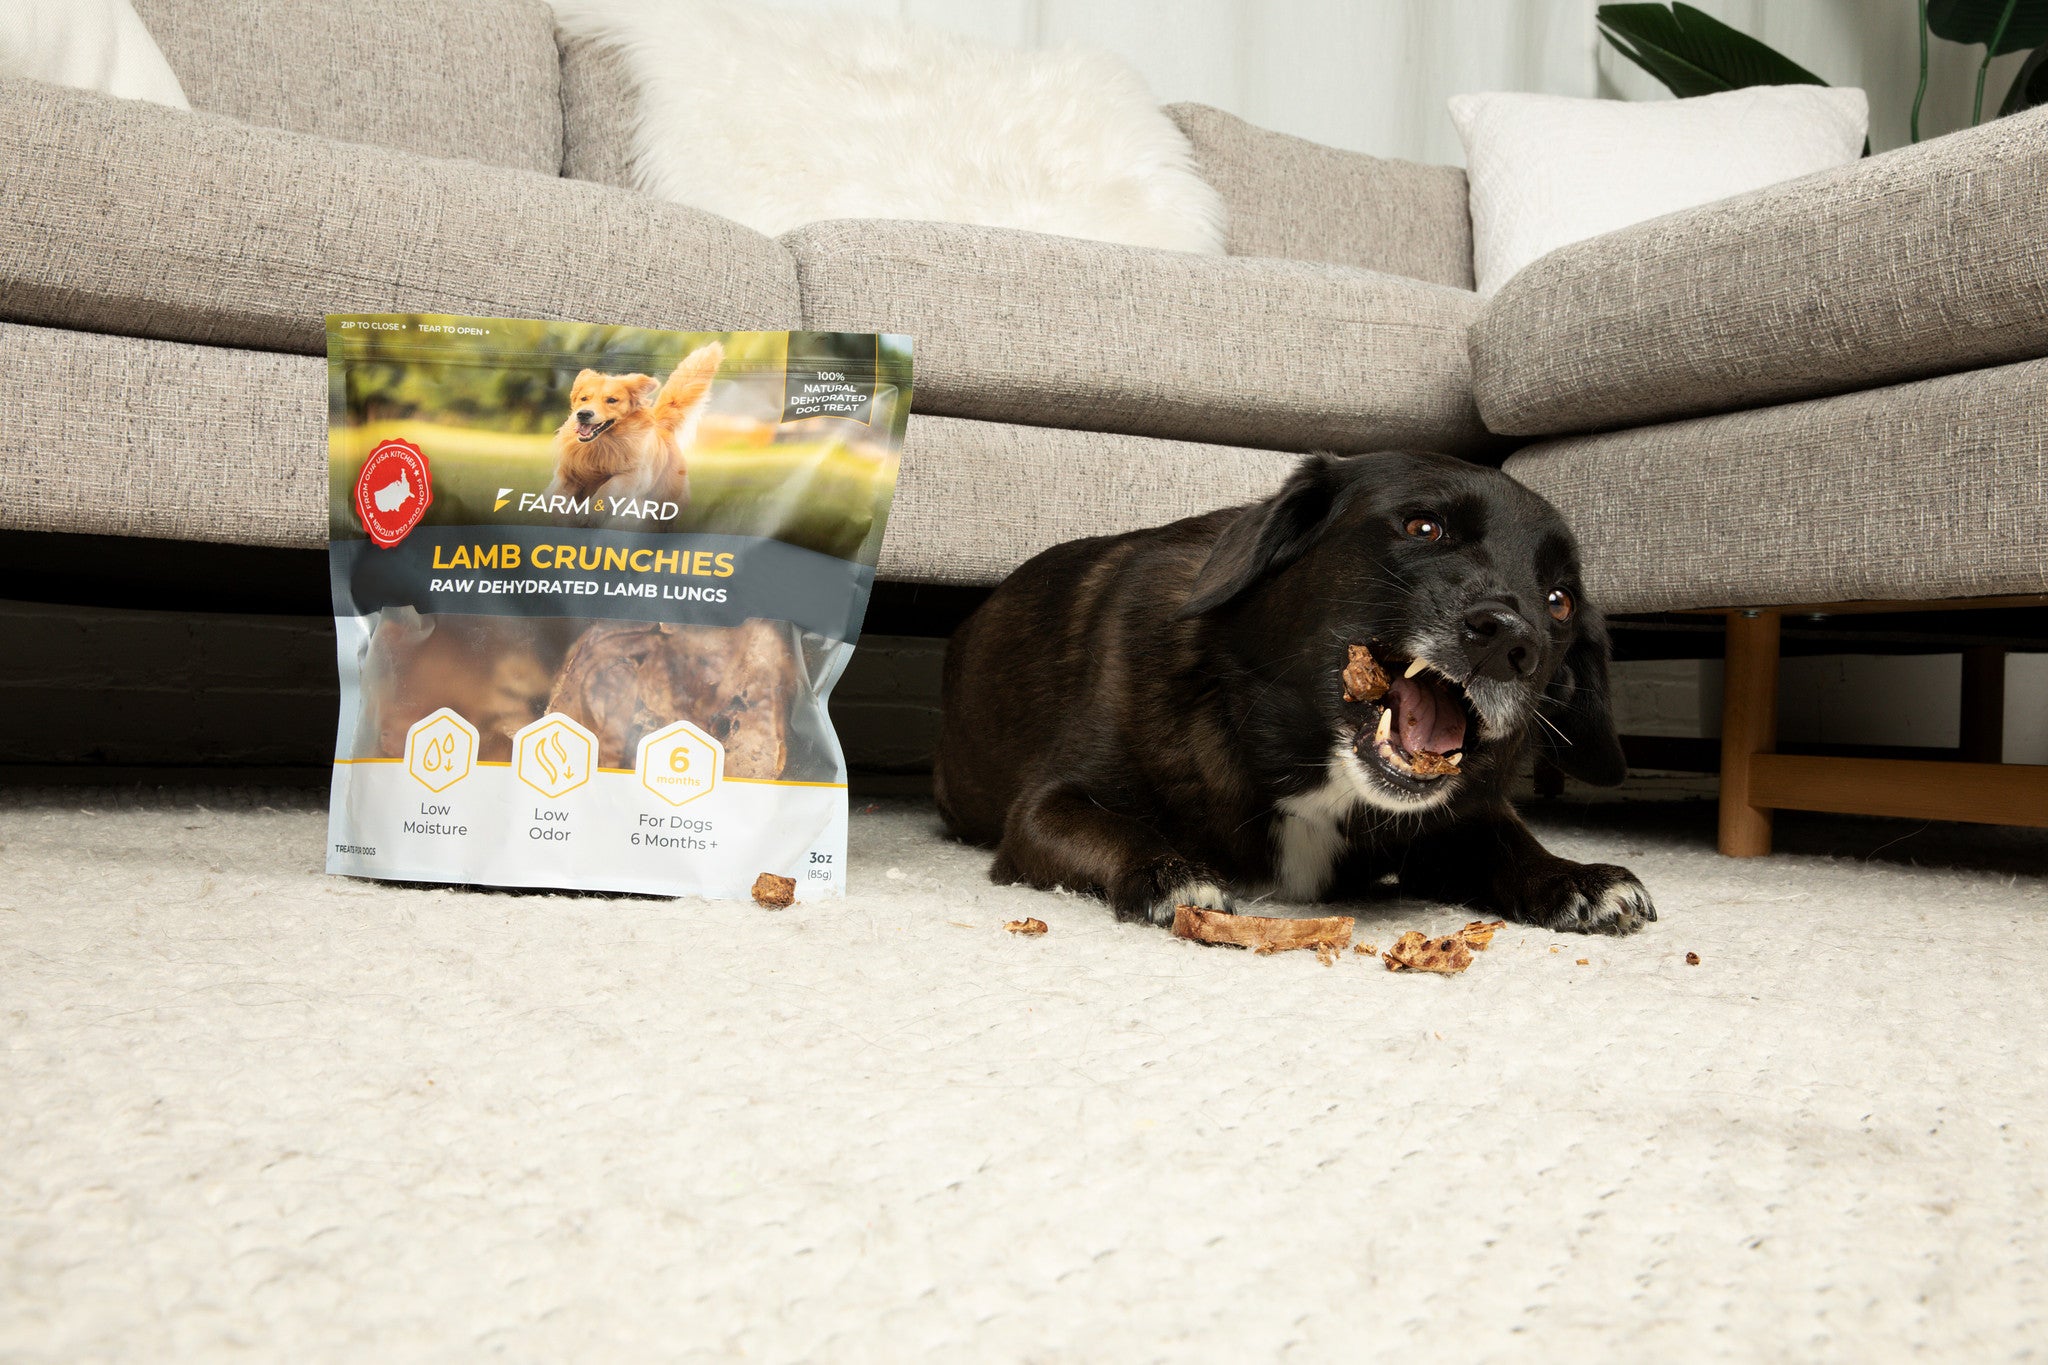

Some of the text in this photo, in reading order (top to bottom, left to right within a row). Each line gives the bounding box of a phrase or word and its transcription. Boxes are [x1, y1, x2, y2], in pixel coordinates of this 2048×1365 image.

[341, 320, 400, 331] ZIP TO CLOSE
[418, 324, 484, 336] TEAR TO OPEN
[816, 372, 846, 381] 100%
[804, 384, 856, 392] NATURAL
[791, 394, 867, 405] DEHYDRATED
[796, 405, 820, 414] DOG
[362, 450, 417, 510] FROM OUR USA KITCHEN
[416, 478, 425, 506] FROM
[518, 492, 679, 521] FARM & YARD
[408, 508, 420, 525] OUR
[372, 519, 395, 537] KITCHEN
[432, 544, 735, 578] LAMB CRUNCHIES
[430, 578, 728, 603] RAW DEHYDRATED LAMB LUNGS
[670, 746, 690, 773] 6
[656, 776, 701, 787] months
[420, 802, 451, 816] Low
[534, 808, 569, 822] Low
[403, 820, 468, 836] Moisture
[639, 813, 713, 833] For Dogs
[529, 827, 572, 841] Odor
[631, 833, 640, 845] 6
[810, 852, 832, 863] 3oz
[808, 870, 832, 880] (85g)
